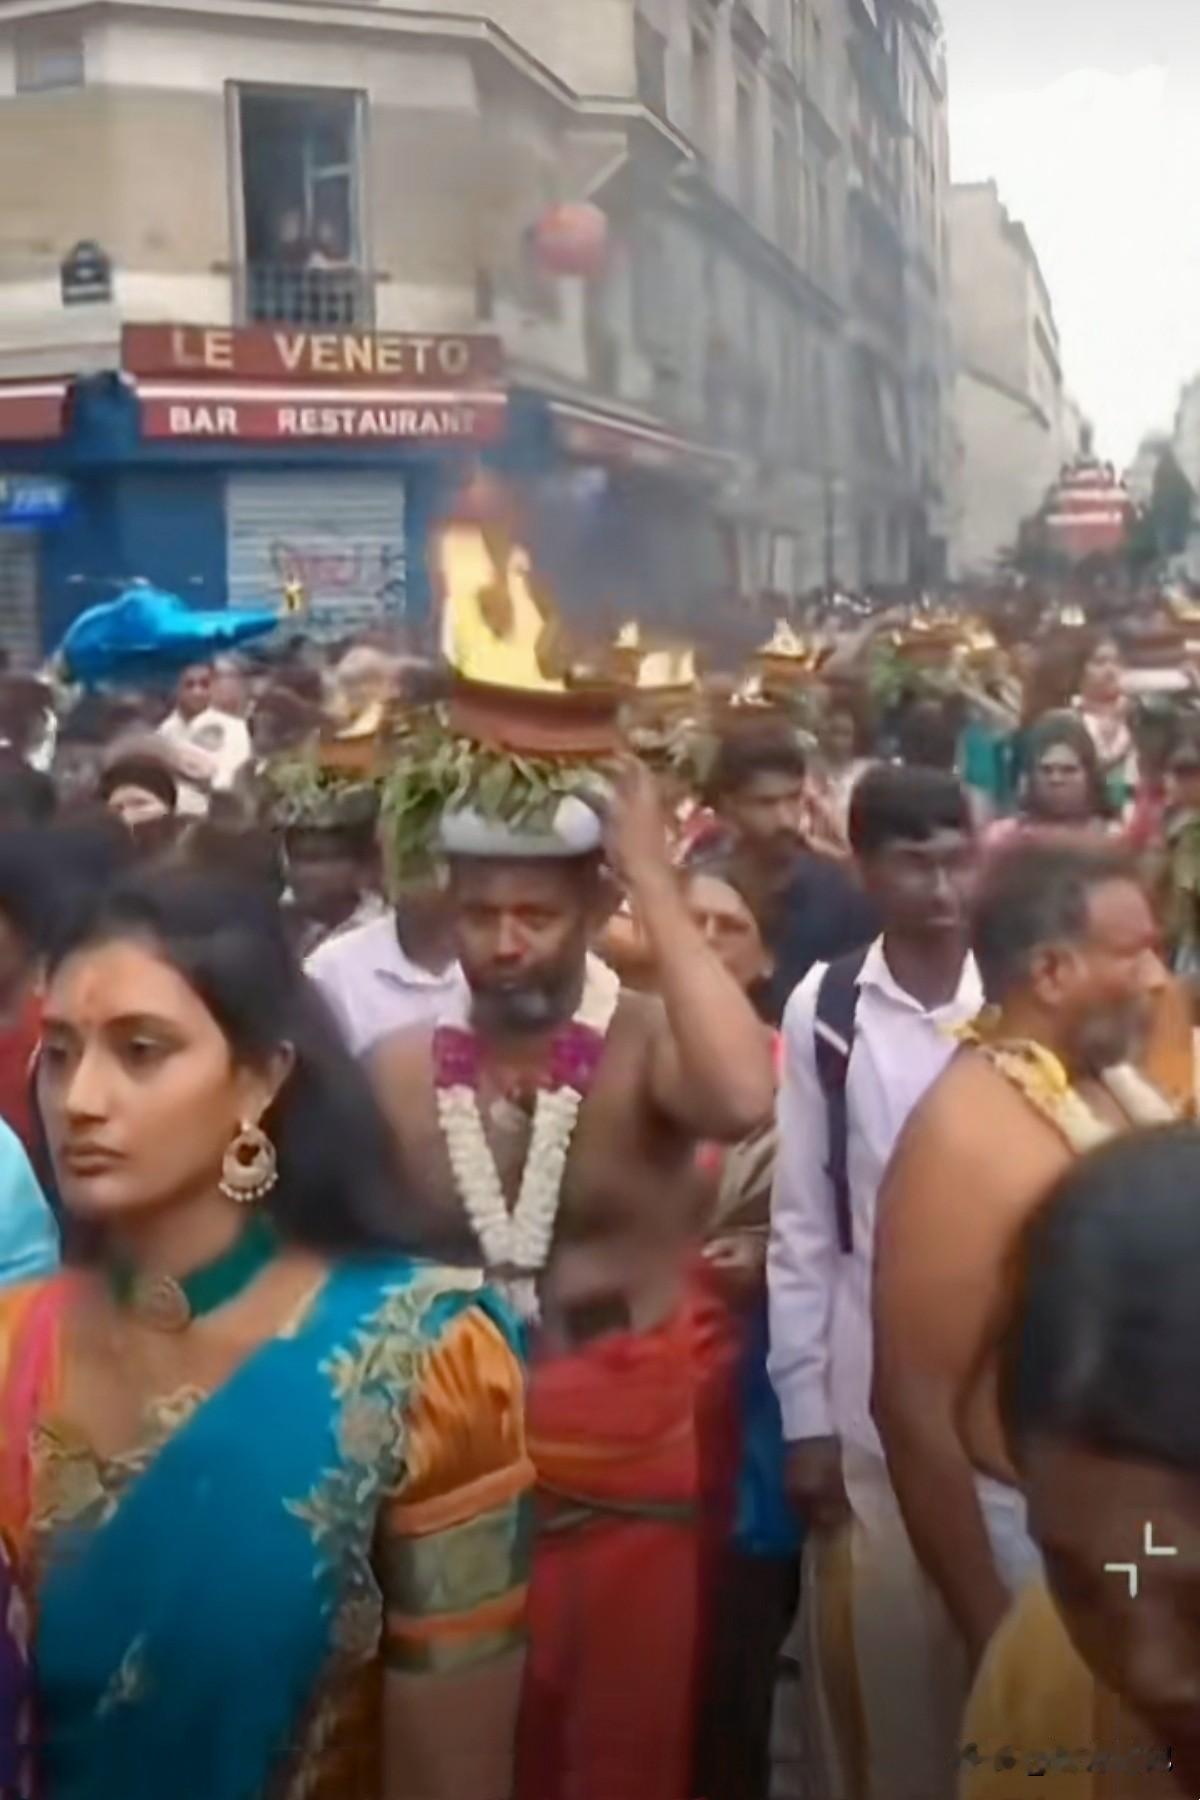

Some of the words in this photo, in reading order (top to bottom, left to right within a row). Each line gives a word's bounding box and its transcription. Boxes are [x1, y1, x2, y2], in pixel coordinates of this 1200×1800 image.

[171, 328, 234, 369] LE
[273, 332, 469, 376] VENETO
[168, 405, 238, 435] BAR
[277, 408, 476, 436] RESTAURANT
